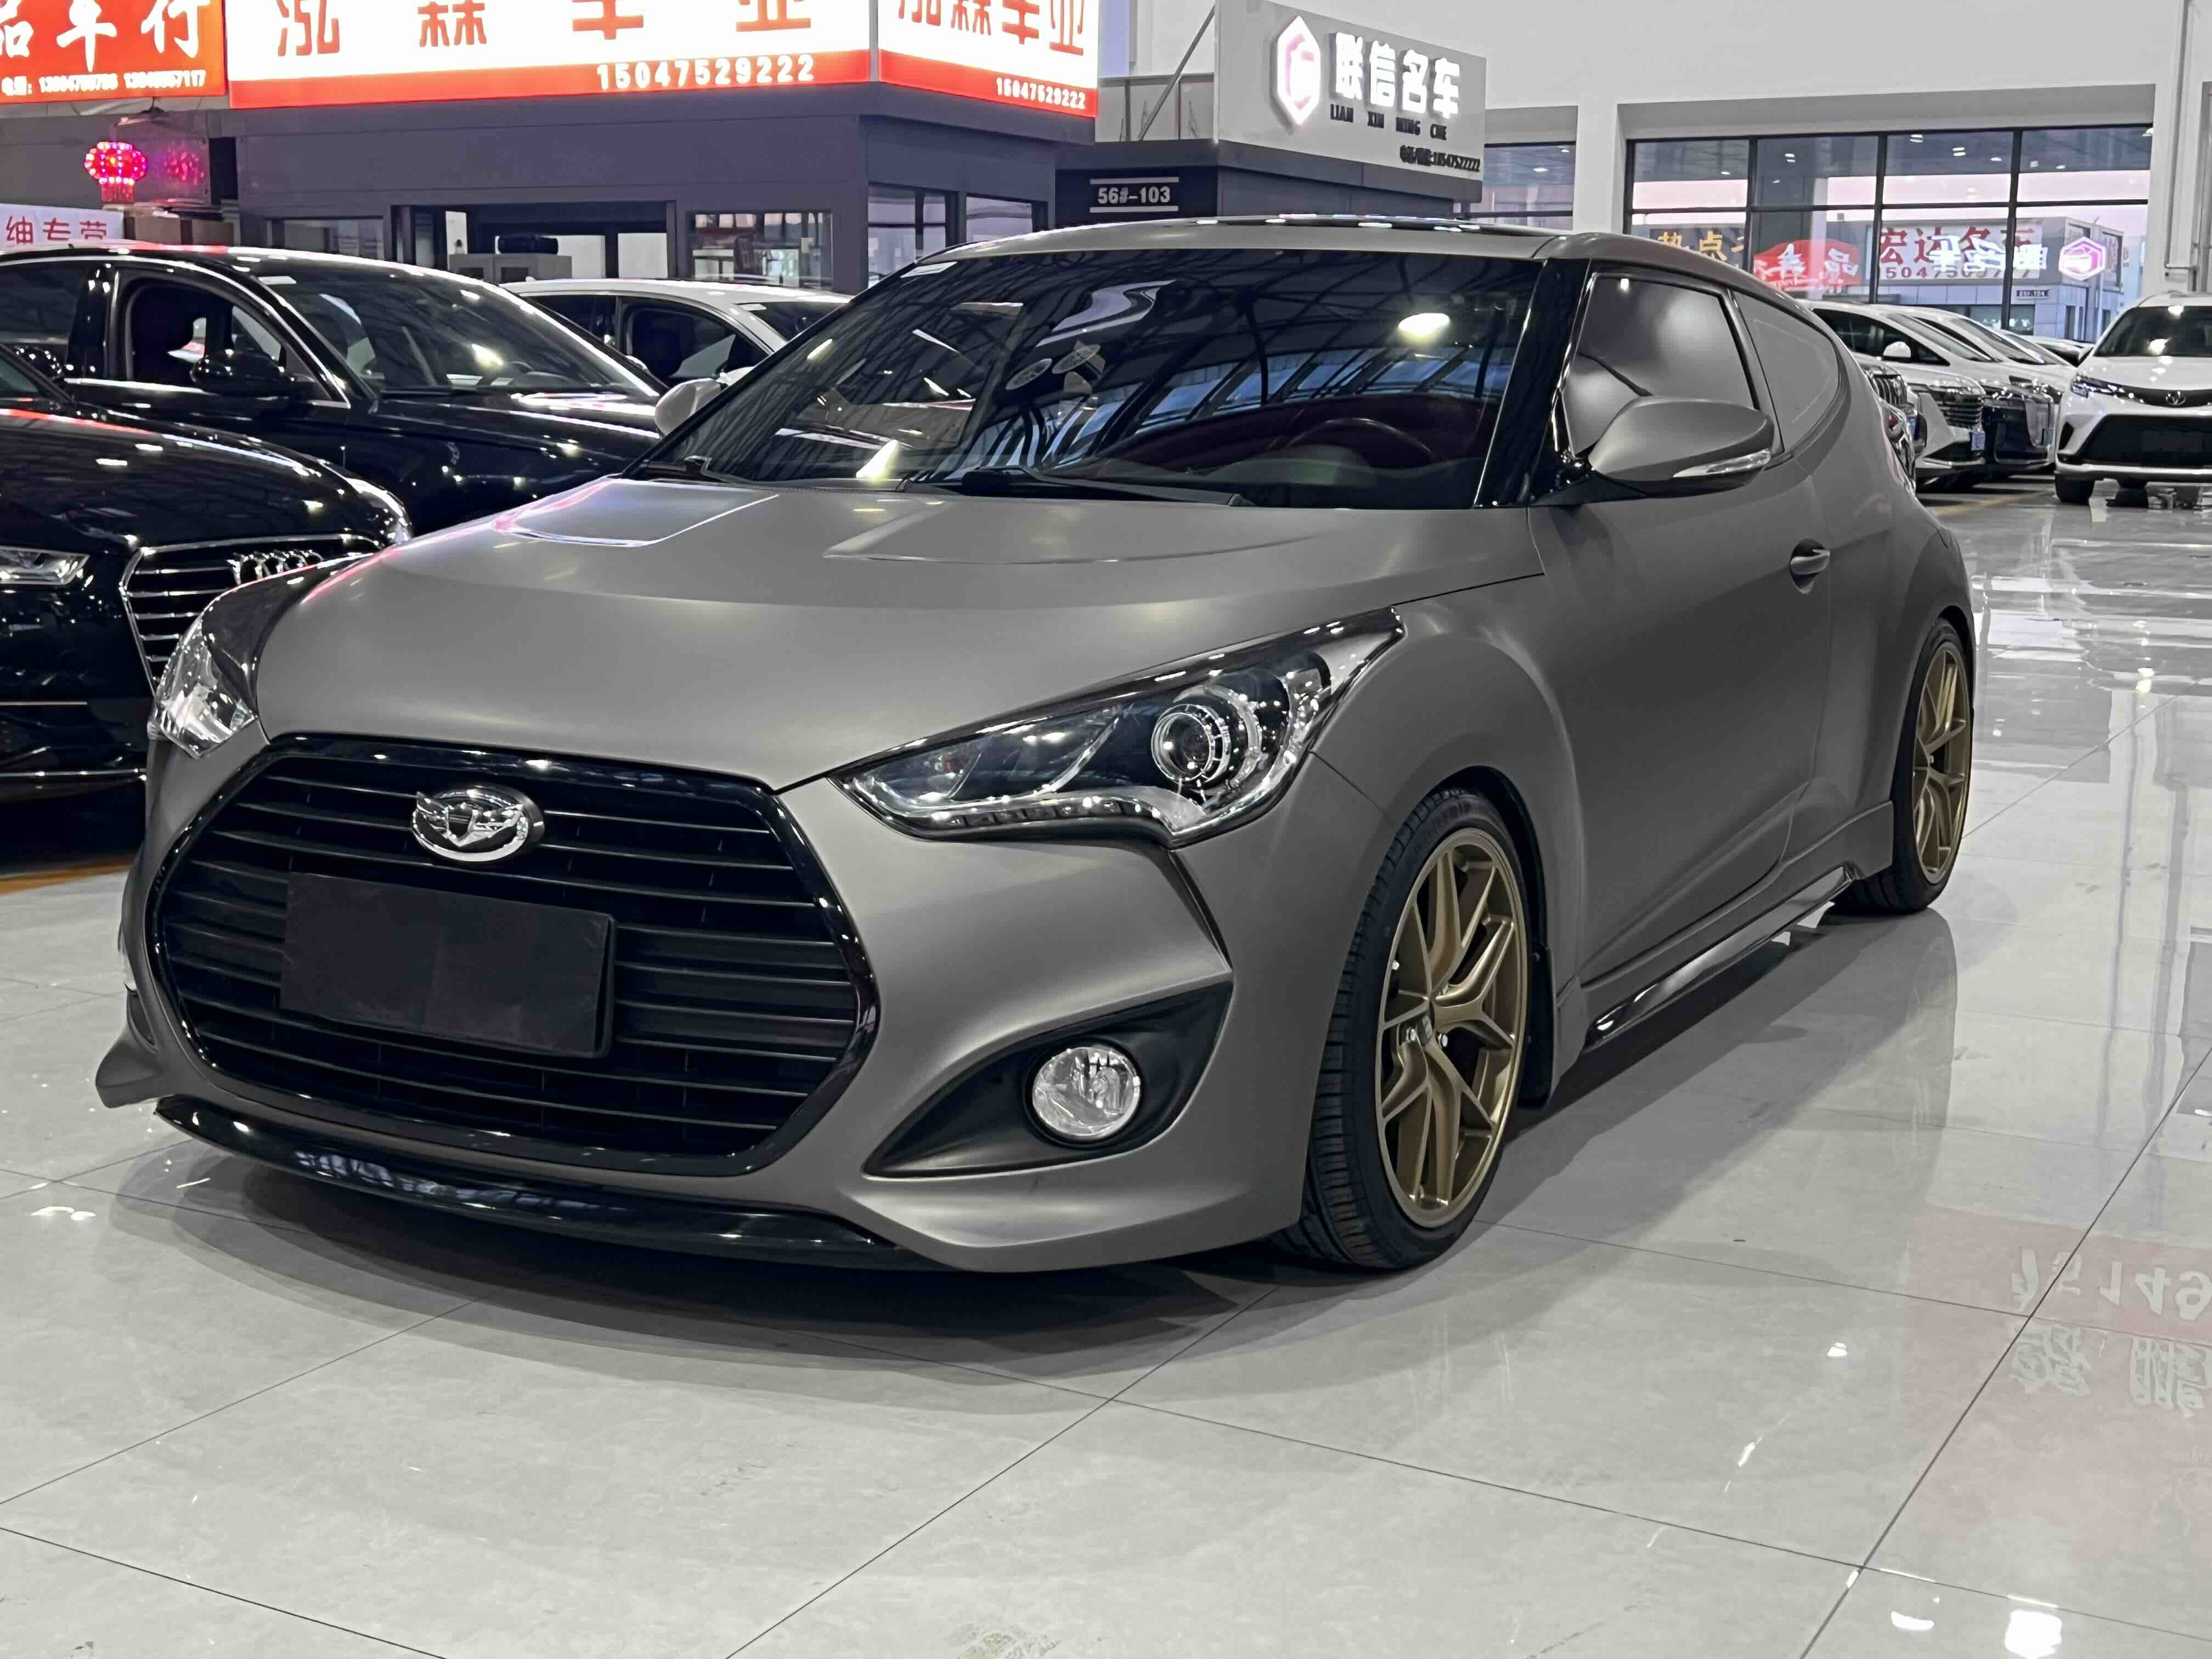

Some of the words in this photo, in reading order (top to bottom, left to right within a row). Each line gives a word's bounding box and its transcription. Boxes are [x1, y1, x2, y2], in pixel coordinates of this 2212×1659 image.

[596, 54, 815, 90] 15047529222
[1335, 31, 1460, 119] 联信名车
[996, 77, 1086, 110] 15047529222
